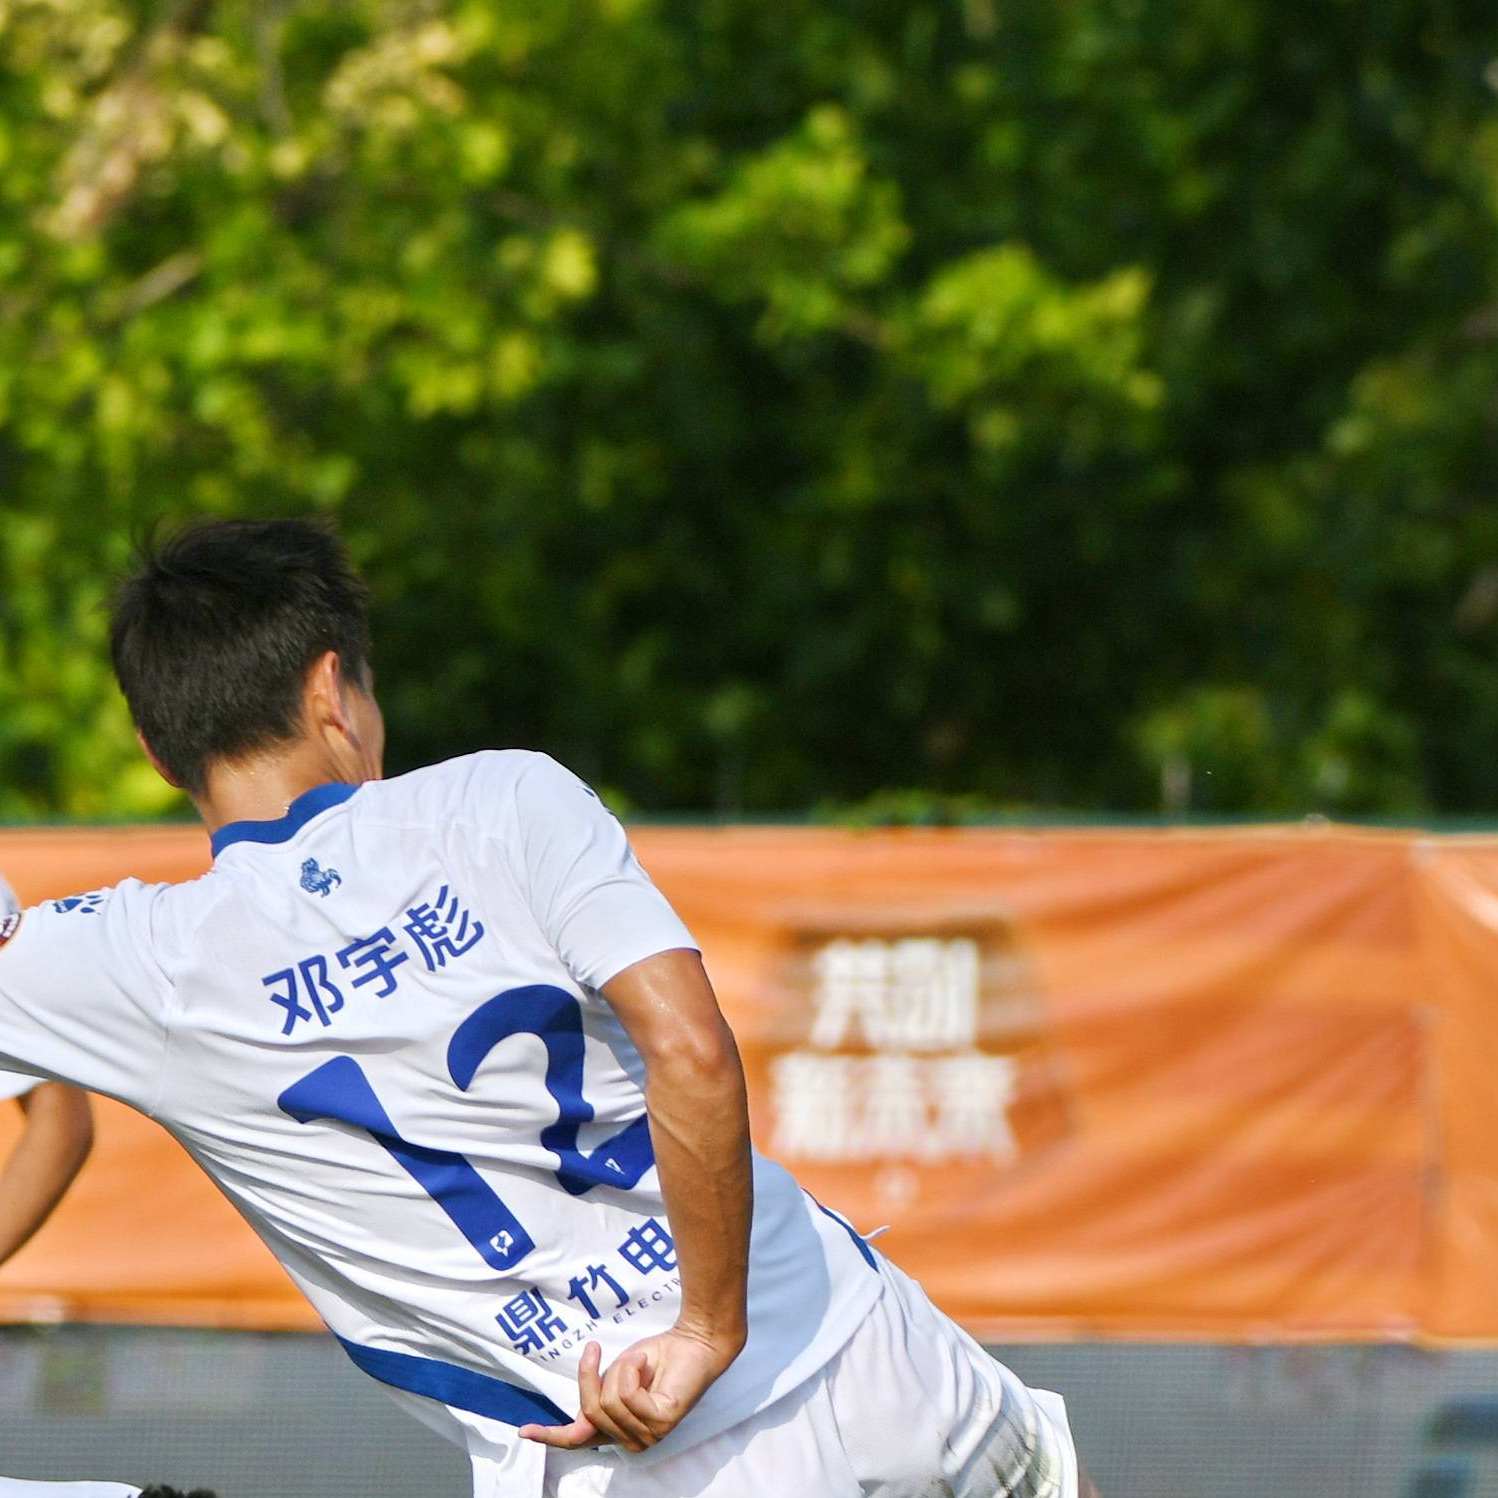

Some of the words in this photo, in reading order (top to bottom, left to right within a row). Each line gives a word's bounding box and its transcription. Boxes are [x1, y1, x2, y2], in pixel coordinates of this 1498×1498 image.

[261, 884, 484, 1036] 邓宇彪
[277, 984, 654, 1271] 12
[494, 1217, 678, 1356] 鼎竹电
[612, 1277, 682, 1325] ELECTR
